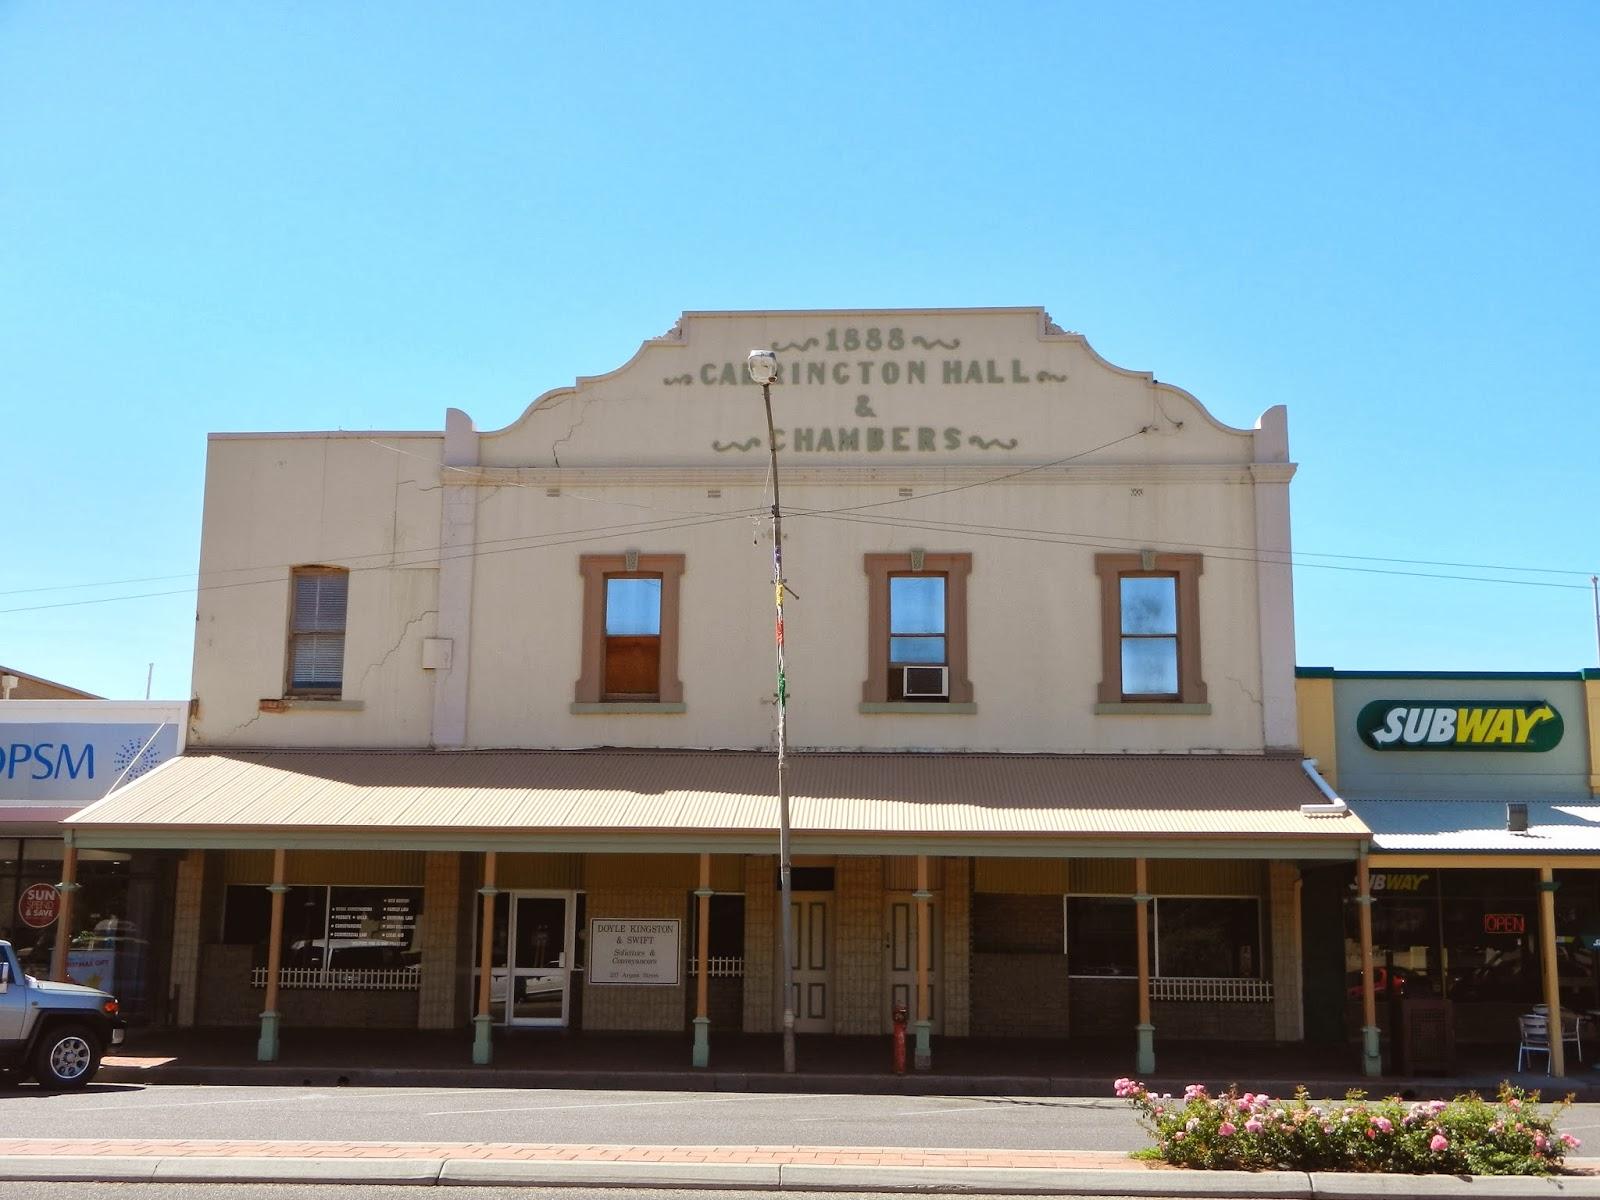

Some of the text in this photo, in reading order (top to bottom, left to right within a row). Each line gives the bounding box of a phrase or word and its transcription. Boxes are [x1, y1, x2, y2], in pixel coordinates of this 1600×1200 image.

[825, 328, 905, 351] 1888
[942, 359, 1031, 384] HALL
[854, 394, 877, 418] &
[772, 427, 962, 452] CHAMBERS
[1373, 705, 1554, 744] SUBWAY
[28, 890, 55, 901] SUN
[33, 909, 53, 917] SAVE
[630, 925, 673, 933] KINGSTON
[1487, 915, 1524, 932] OPEN
[616, 936, 655, 944] & SWIFT
